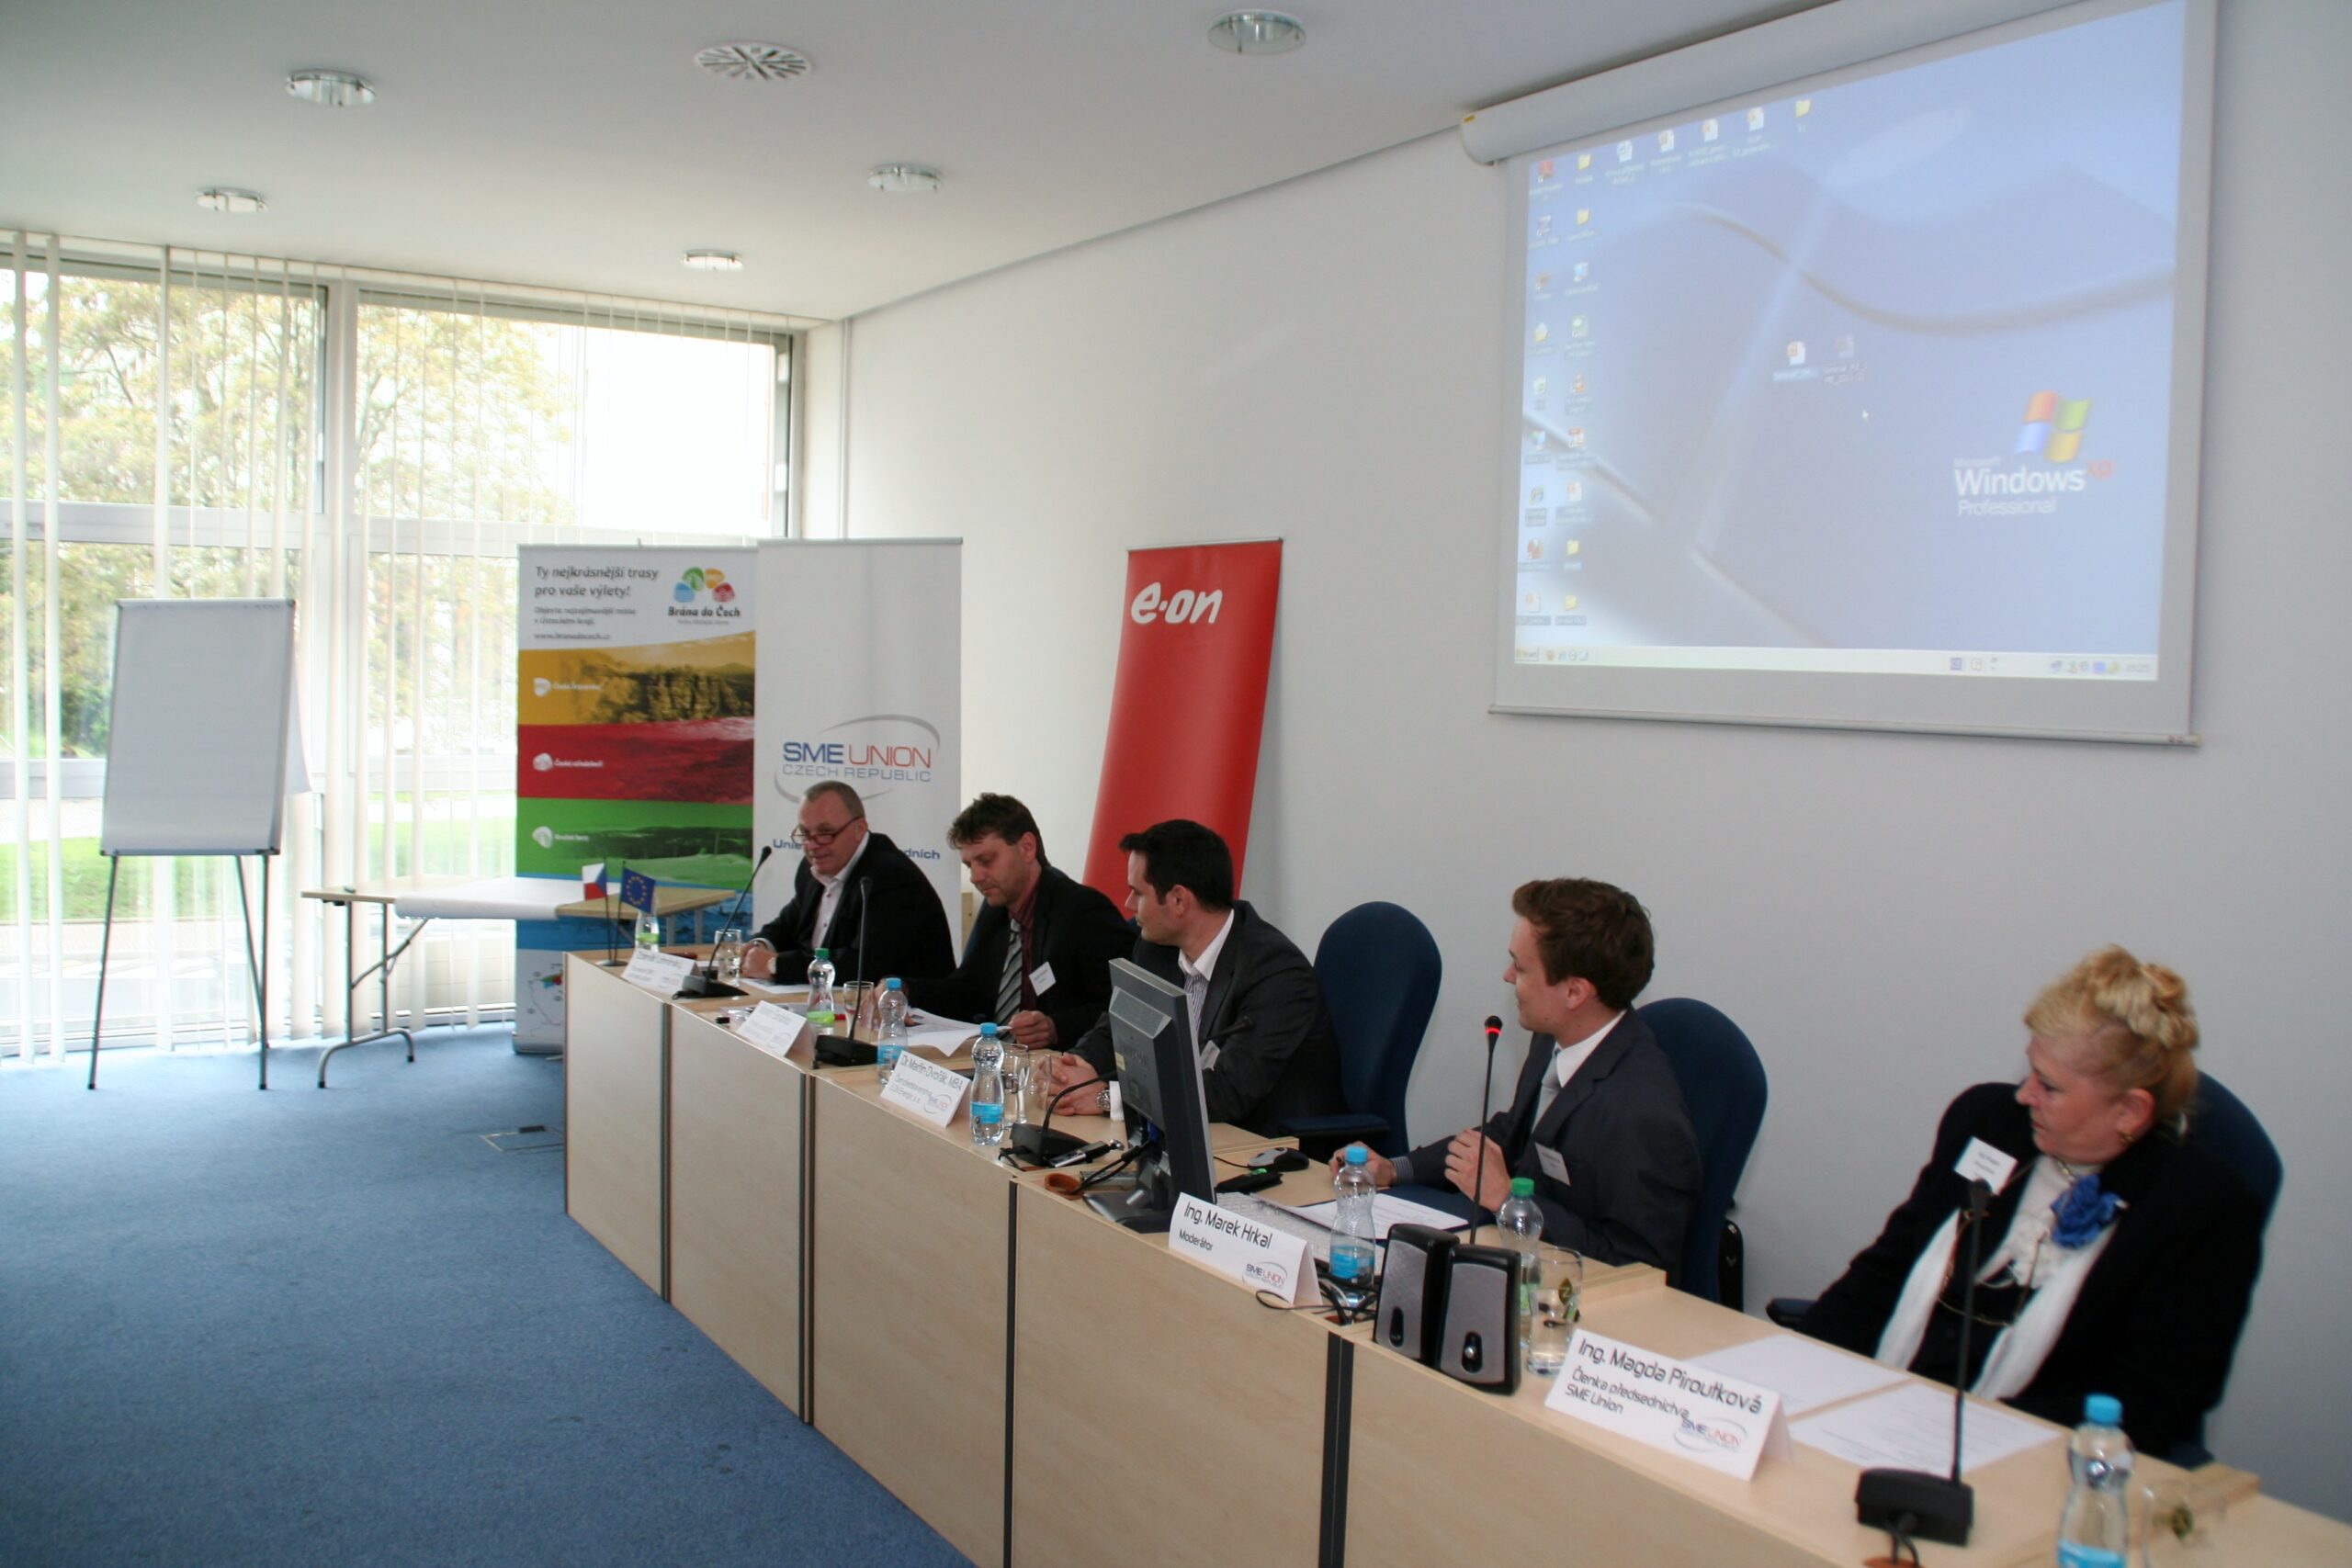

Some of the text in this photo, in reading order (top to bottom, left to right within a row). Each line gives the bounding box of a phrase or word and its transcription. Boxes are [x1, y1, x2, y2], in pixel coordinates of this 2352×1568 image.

[1954, 465, 2086, 496] Windows
[1958, 497, 2058, 516] Professional
[536, 565, 659, 581] Ty nejkrásnější trasy
[534, 583, 631, 599] pro vaše výlety!
[668, 604, 741, 616] Brána do Čech
[783, 741, 931, 769] SME UNION
[782, 763, 931, 783] CZECH REPUBLIC
[773, 838, 941, 861] Unie dních
[1183, 1201, 1273, 1249] Ing. Marek Hrkal
[1246, 1263, 1263, 1277] SME
[1577, 1337, 1763, 1415] Ing. Magda Piroutková
[1566, 1383, 1624, 1415] SME Union
[1572, 1364, 1690, 1420] Členka předsednictva
[1680, 1417, 1706, 1435] SME
